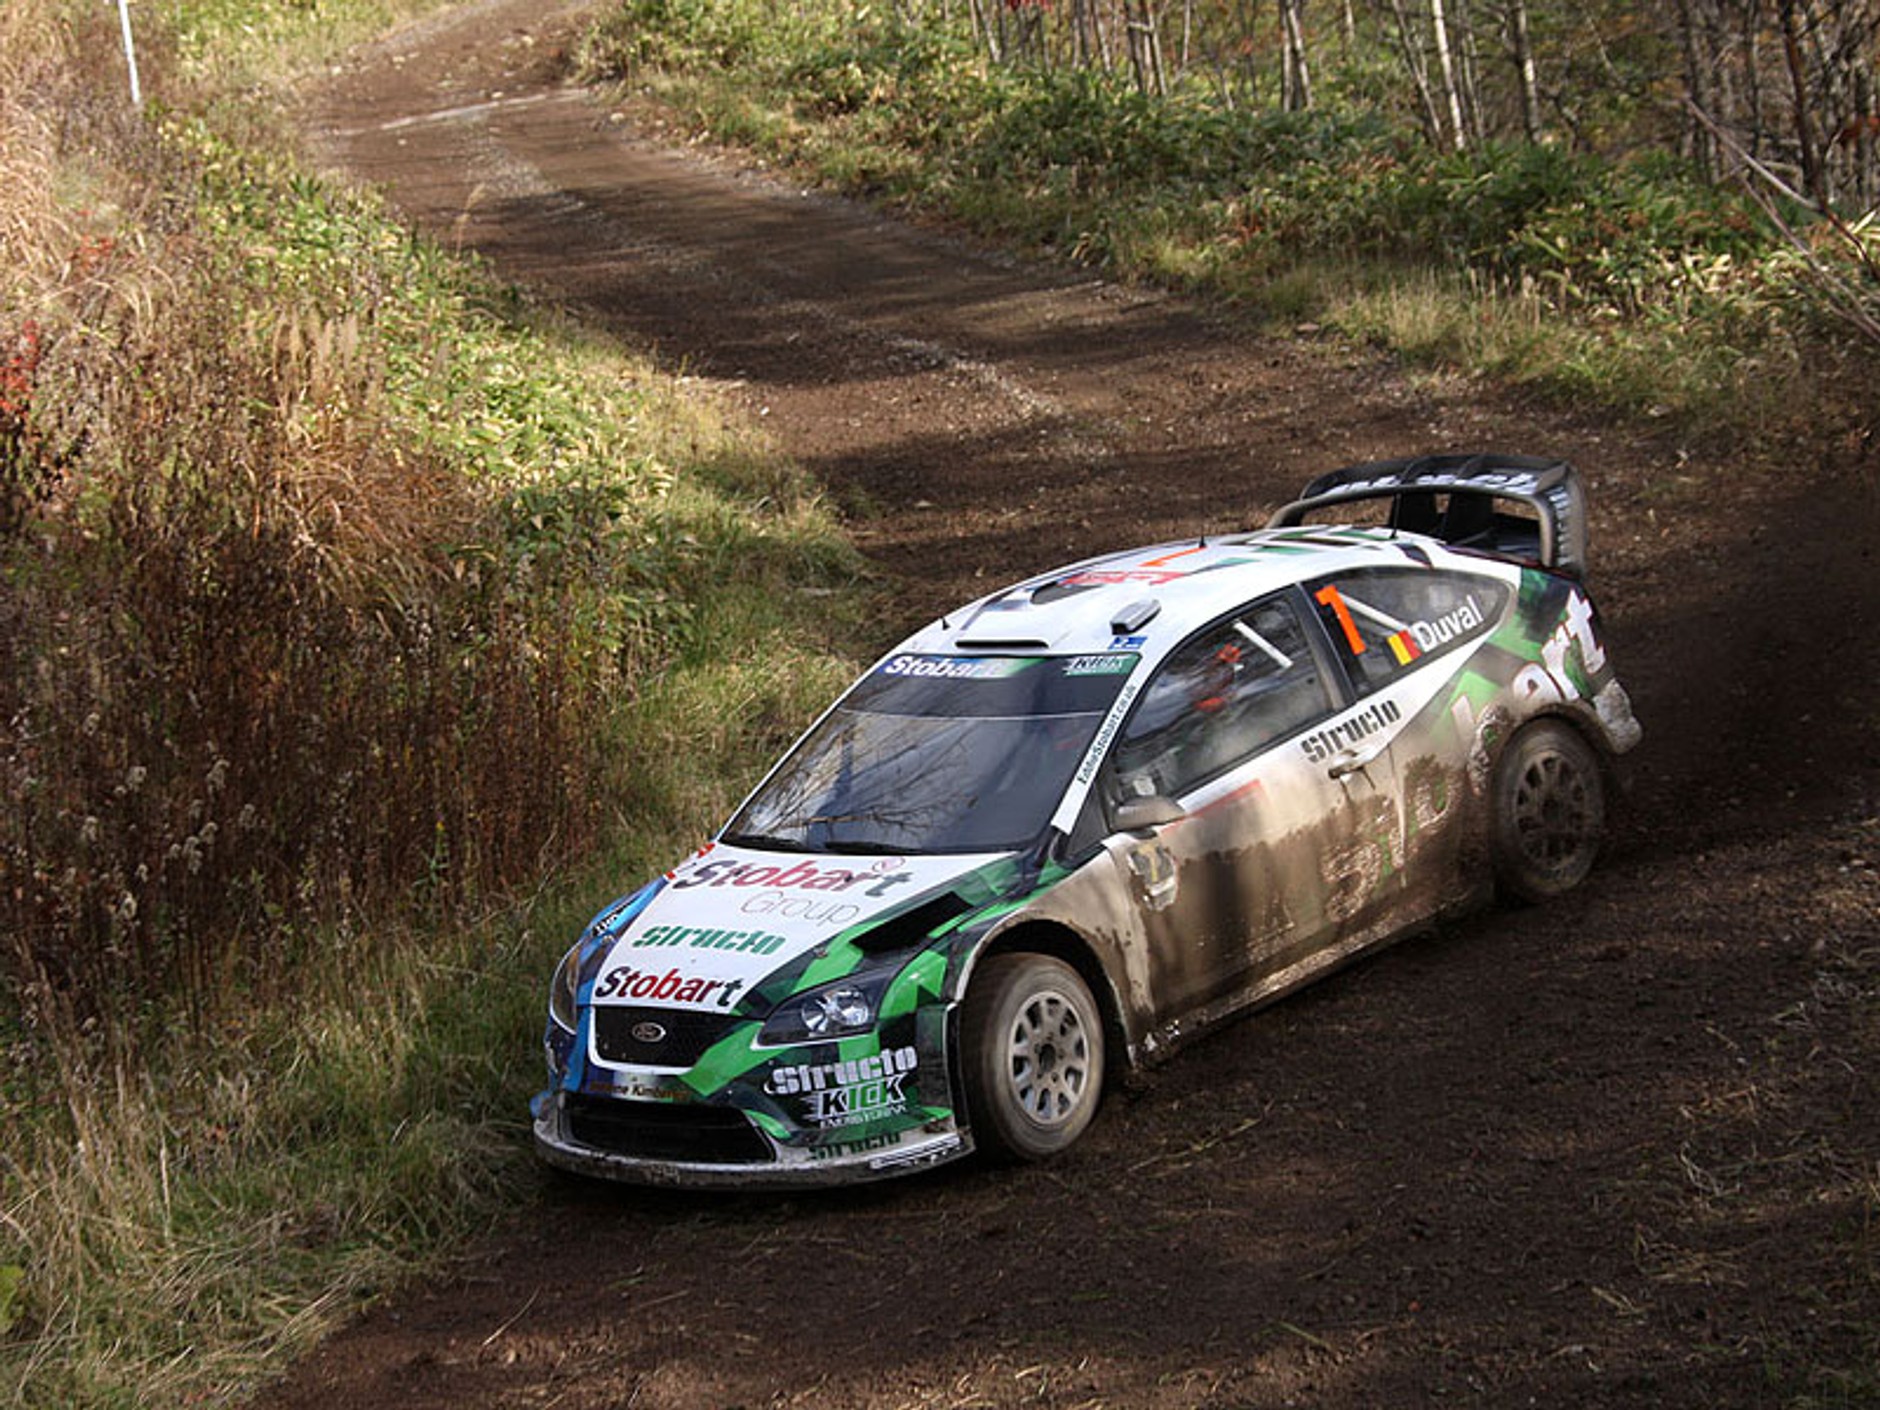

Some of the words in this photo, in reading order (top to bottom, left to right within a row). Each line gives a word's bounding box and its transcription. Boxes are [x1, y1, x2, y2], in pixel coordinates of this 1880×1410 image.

[1315, 584, 1366, 656] 1
[1412, 595, 1484, 653] Duval
[673, 859, 914, 897] Stobart
[740, 890, 860, 927] Group
[595, 966, 744, 1006] Stobart
